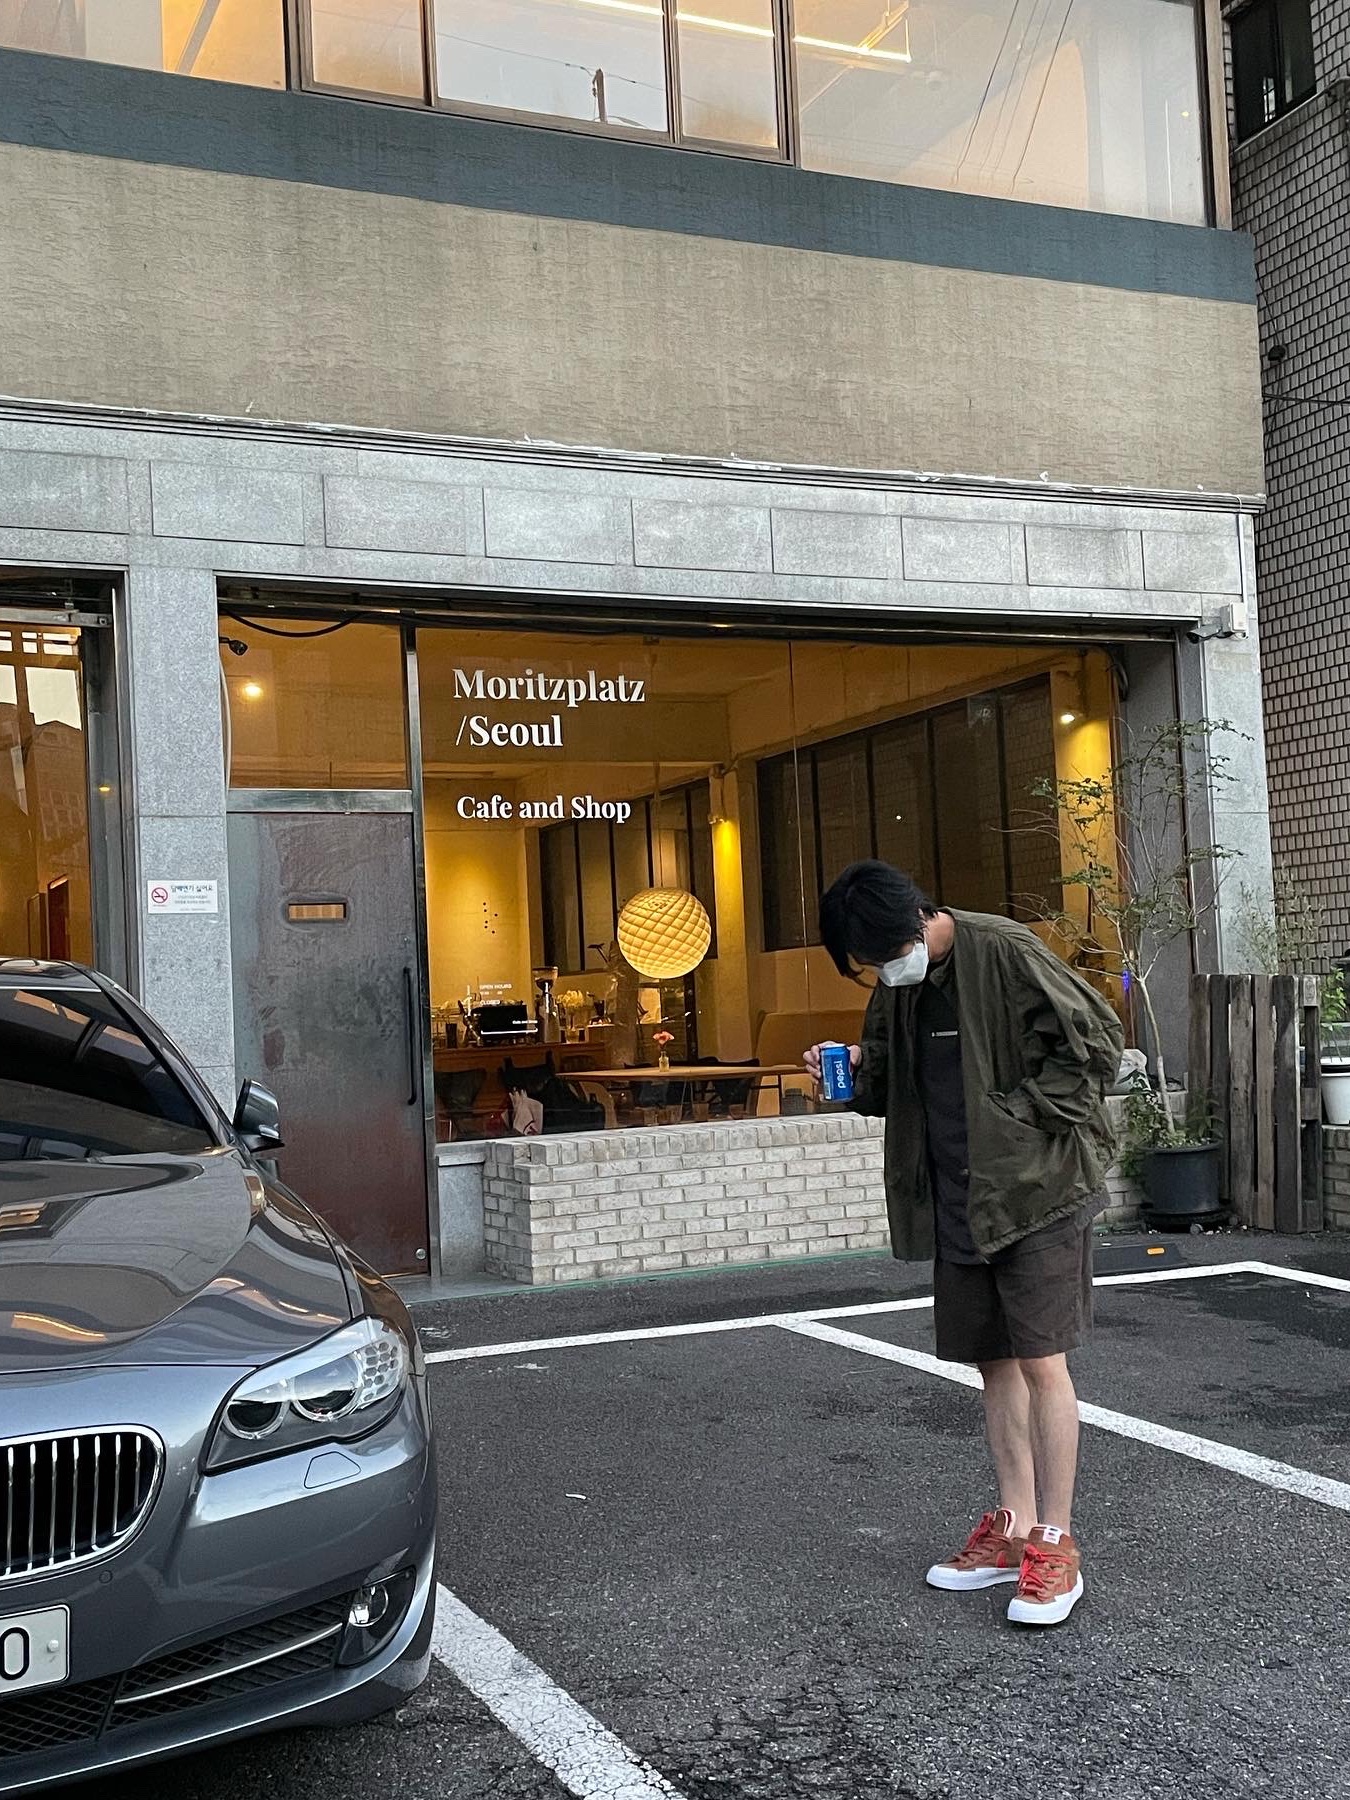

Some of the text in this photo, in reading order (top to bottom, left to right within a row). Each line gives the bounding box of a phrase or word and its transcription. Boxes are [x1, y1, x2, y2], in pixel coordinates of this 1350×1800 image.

[452, 668, 645, 708] Moritzplatz
[455, 714, 563, 747] /Seoul
[456, 795, 631, 824] Cafe and Shop
[833, 1060, 847, 1089] pepsi
